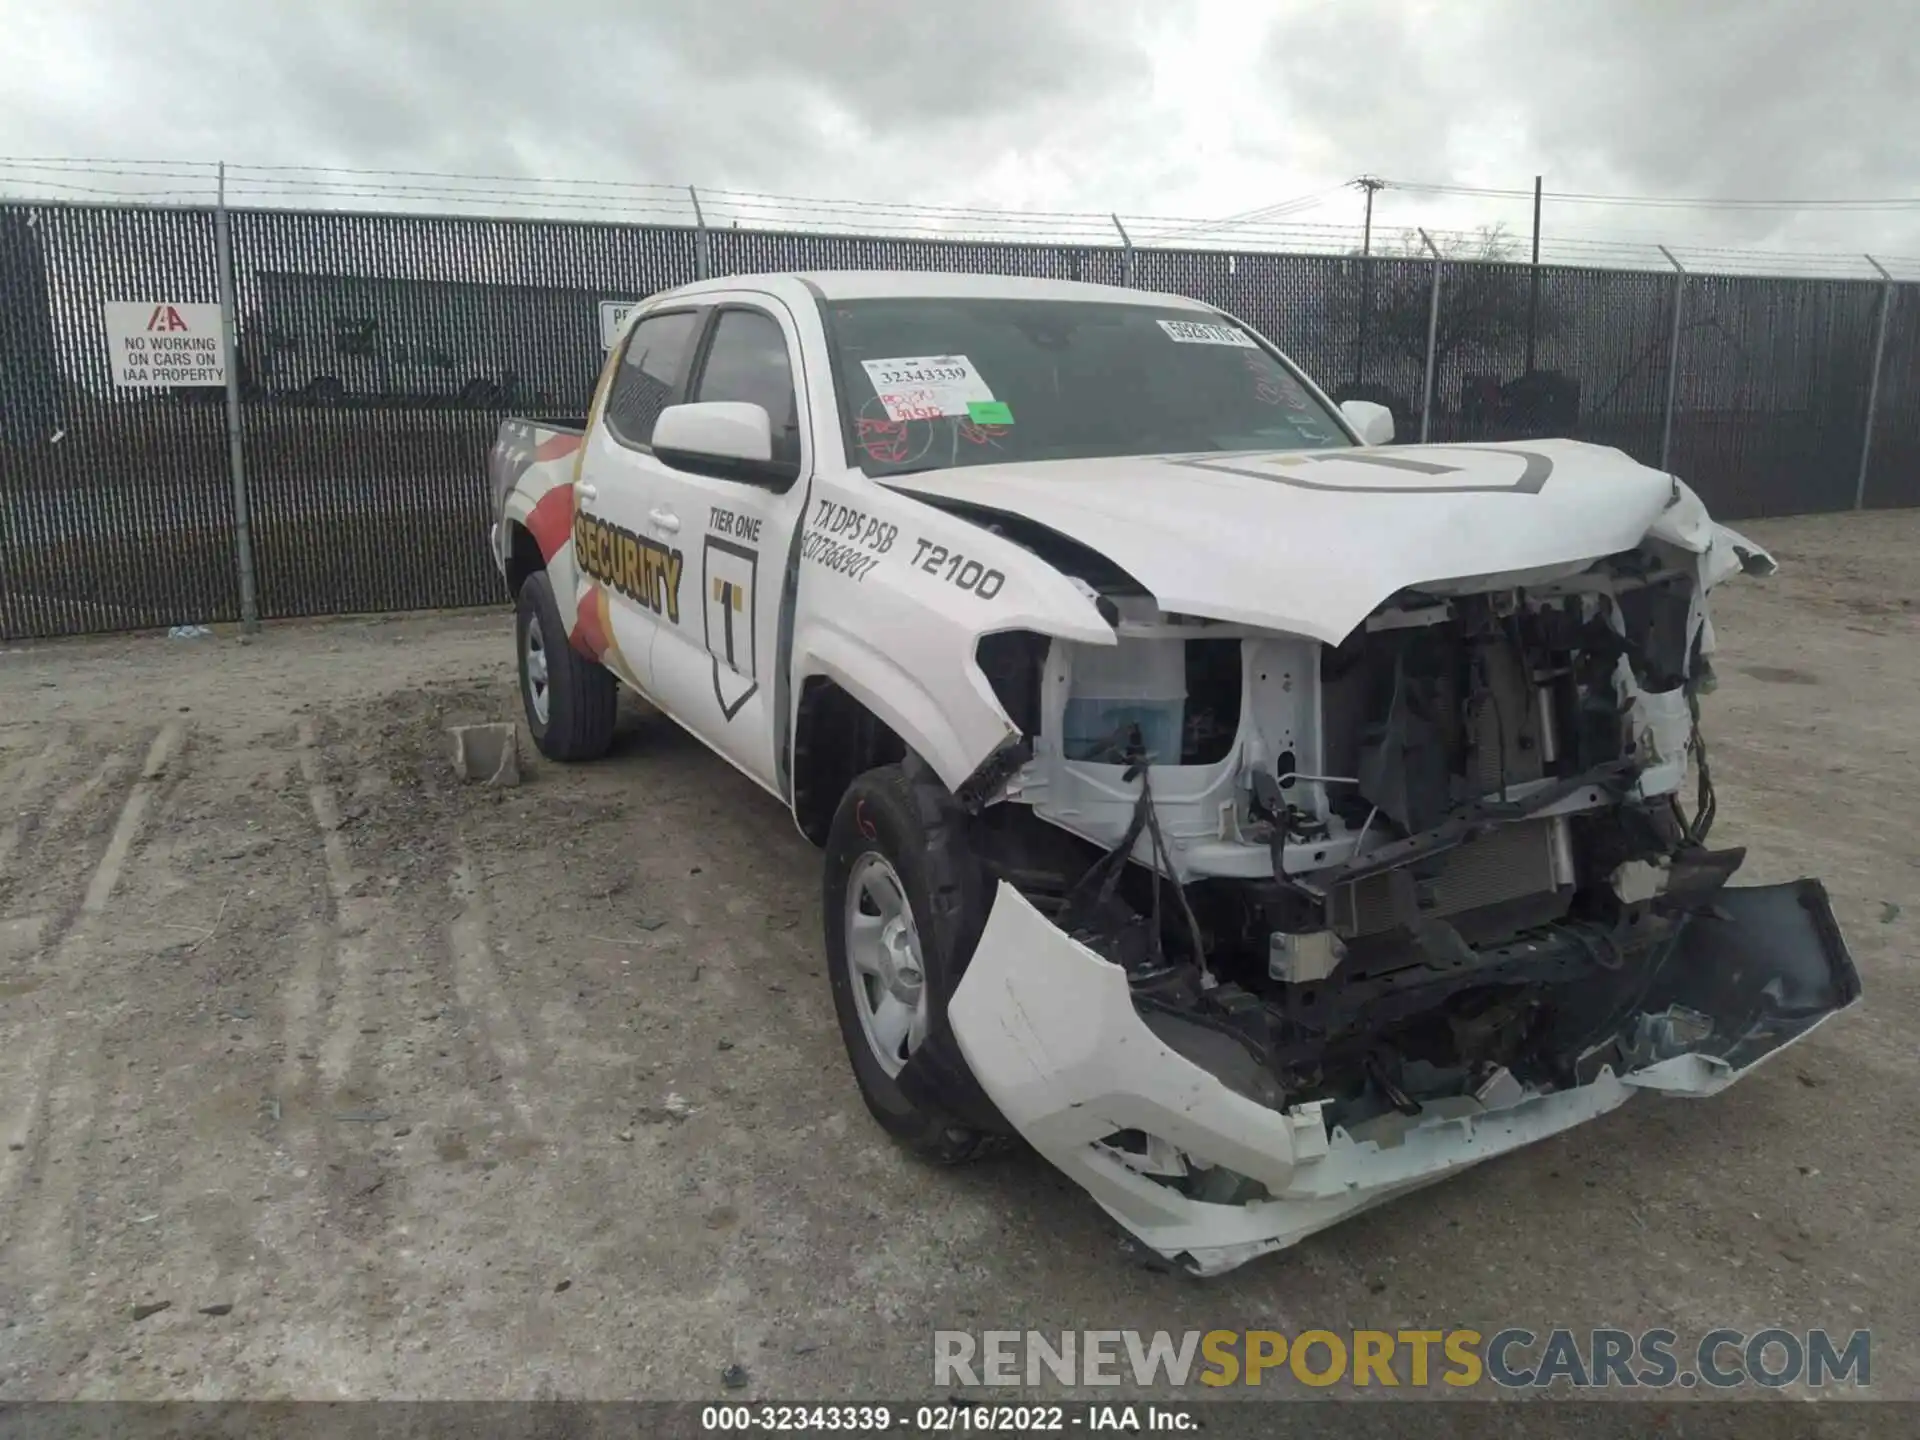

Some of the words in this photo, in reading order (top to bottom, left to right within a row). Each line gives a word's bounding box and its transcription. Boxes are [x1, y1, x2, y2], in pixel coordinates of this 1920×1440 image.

[124, 337, 145, 350] NO
[150, 338, 216, 350] WORKING
[128, 353, 149, 366] ON
[153, 353, 192, 366] CARS
[196, 353, 216, 366] ON
[123, 368, 148, 381] IAA
[152, 368, 224, 381] PROPERTY
[880, 367, 967, 385] 32343339
[709, 506, 733, 535] TIER
[735, 514, 763, 542] ONE
[813, 500, 837, 530] TX
[830, 506, 866, 541] DPS
[860, 517, 899, 554] PSB
[575, 508, 683, 625] SECURITY
[910, 537, 1006, 601] T2100
